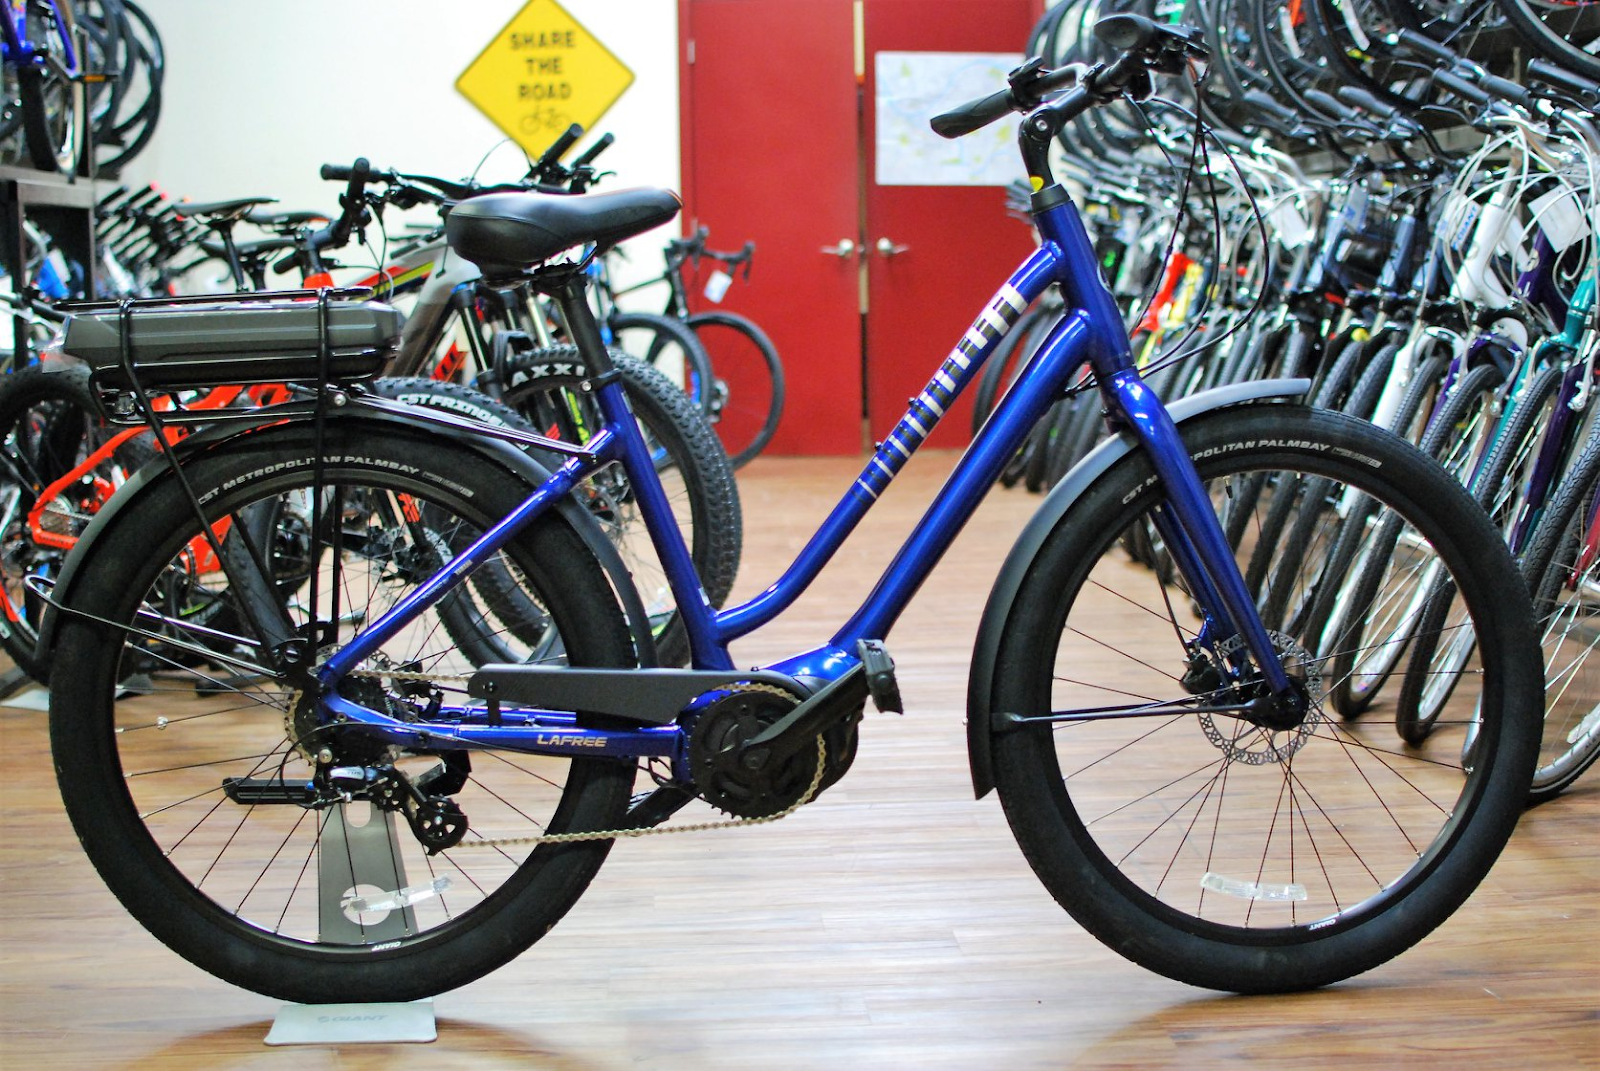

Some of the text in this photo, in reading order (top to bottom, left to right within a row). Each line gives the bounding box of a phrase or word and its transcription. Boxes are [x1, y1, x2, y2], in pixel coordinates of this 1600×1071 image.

[510, 31, 576, 49] SHARE
[525, 57, 563, 74] THE
[518, 83, 571, 100] ROAD
[502, 363, 586, 393] AXXI
[198, 487, 220, 505] CST
[344, 456, 420, 474] PALMBAY
[1122, 484, 1143, 505] CST
[1258, 439, 1331, 452] PALMBAY
[537, 734, 608, 748] LAFREE
[372, 941, 402, 952] GIANT
[332, 1014, 389, 1022] GIANT
